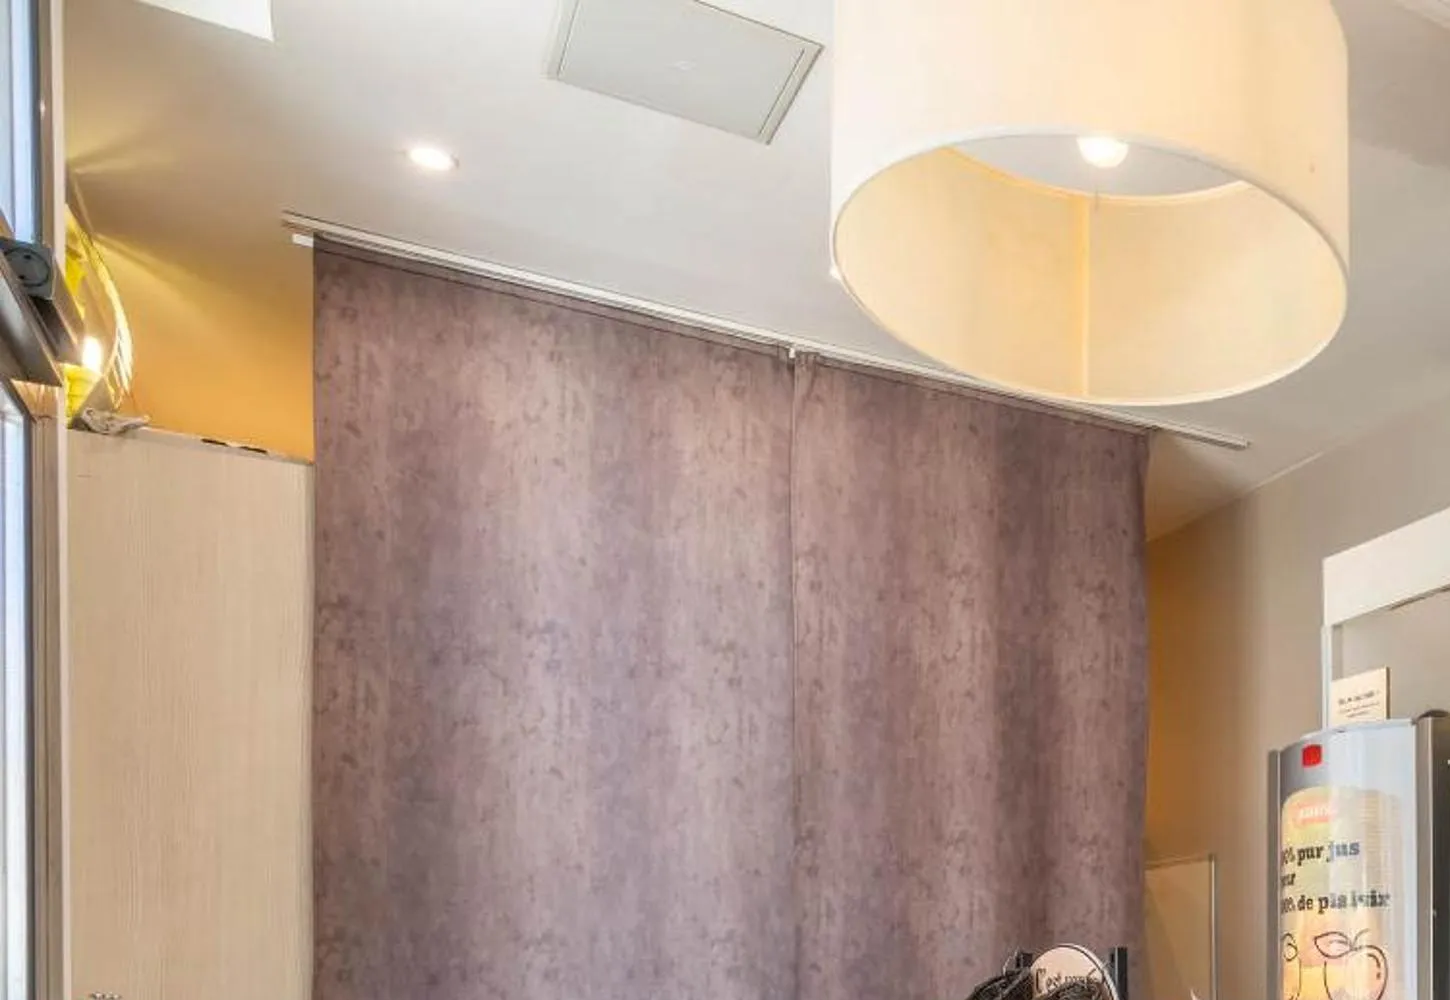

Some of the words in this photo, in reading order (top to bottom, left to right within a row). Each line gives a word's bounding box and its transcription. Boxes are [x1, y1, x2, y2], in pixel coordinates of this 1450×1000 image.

[1297, 846, 1324, 866] pur
[1326, 840, 1360, 863] jus
[1297, 894, 1314, 911] de
